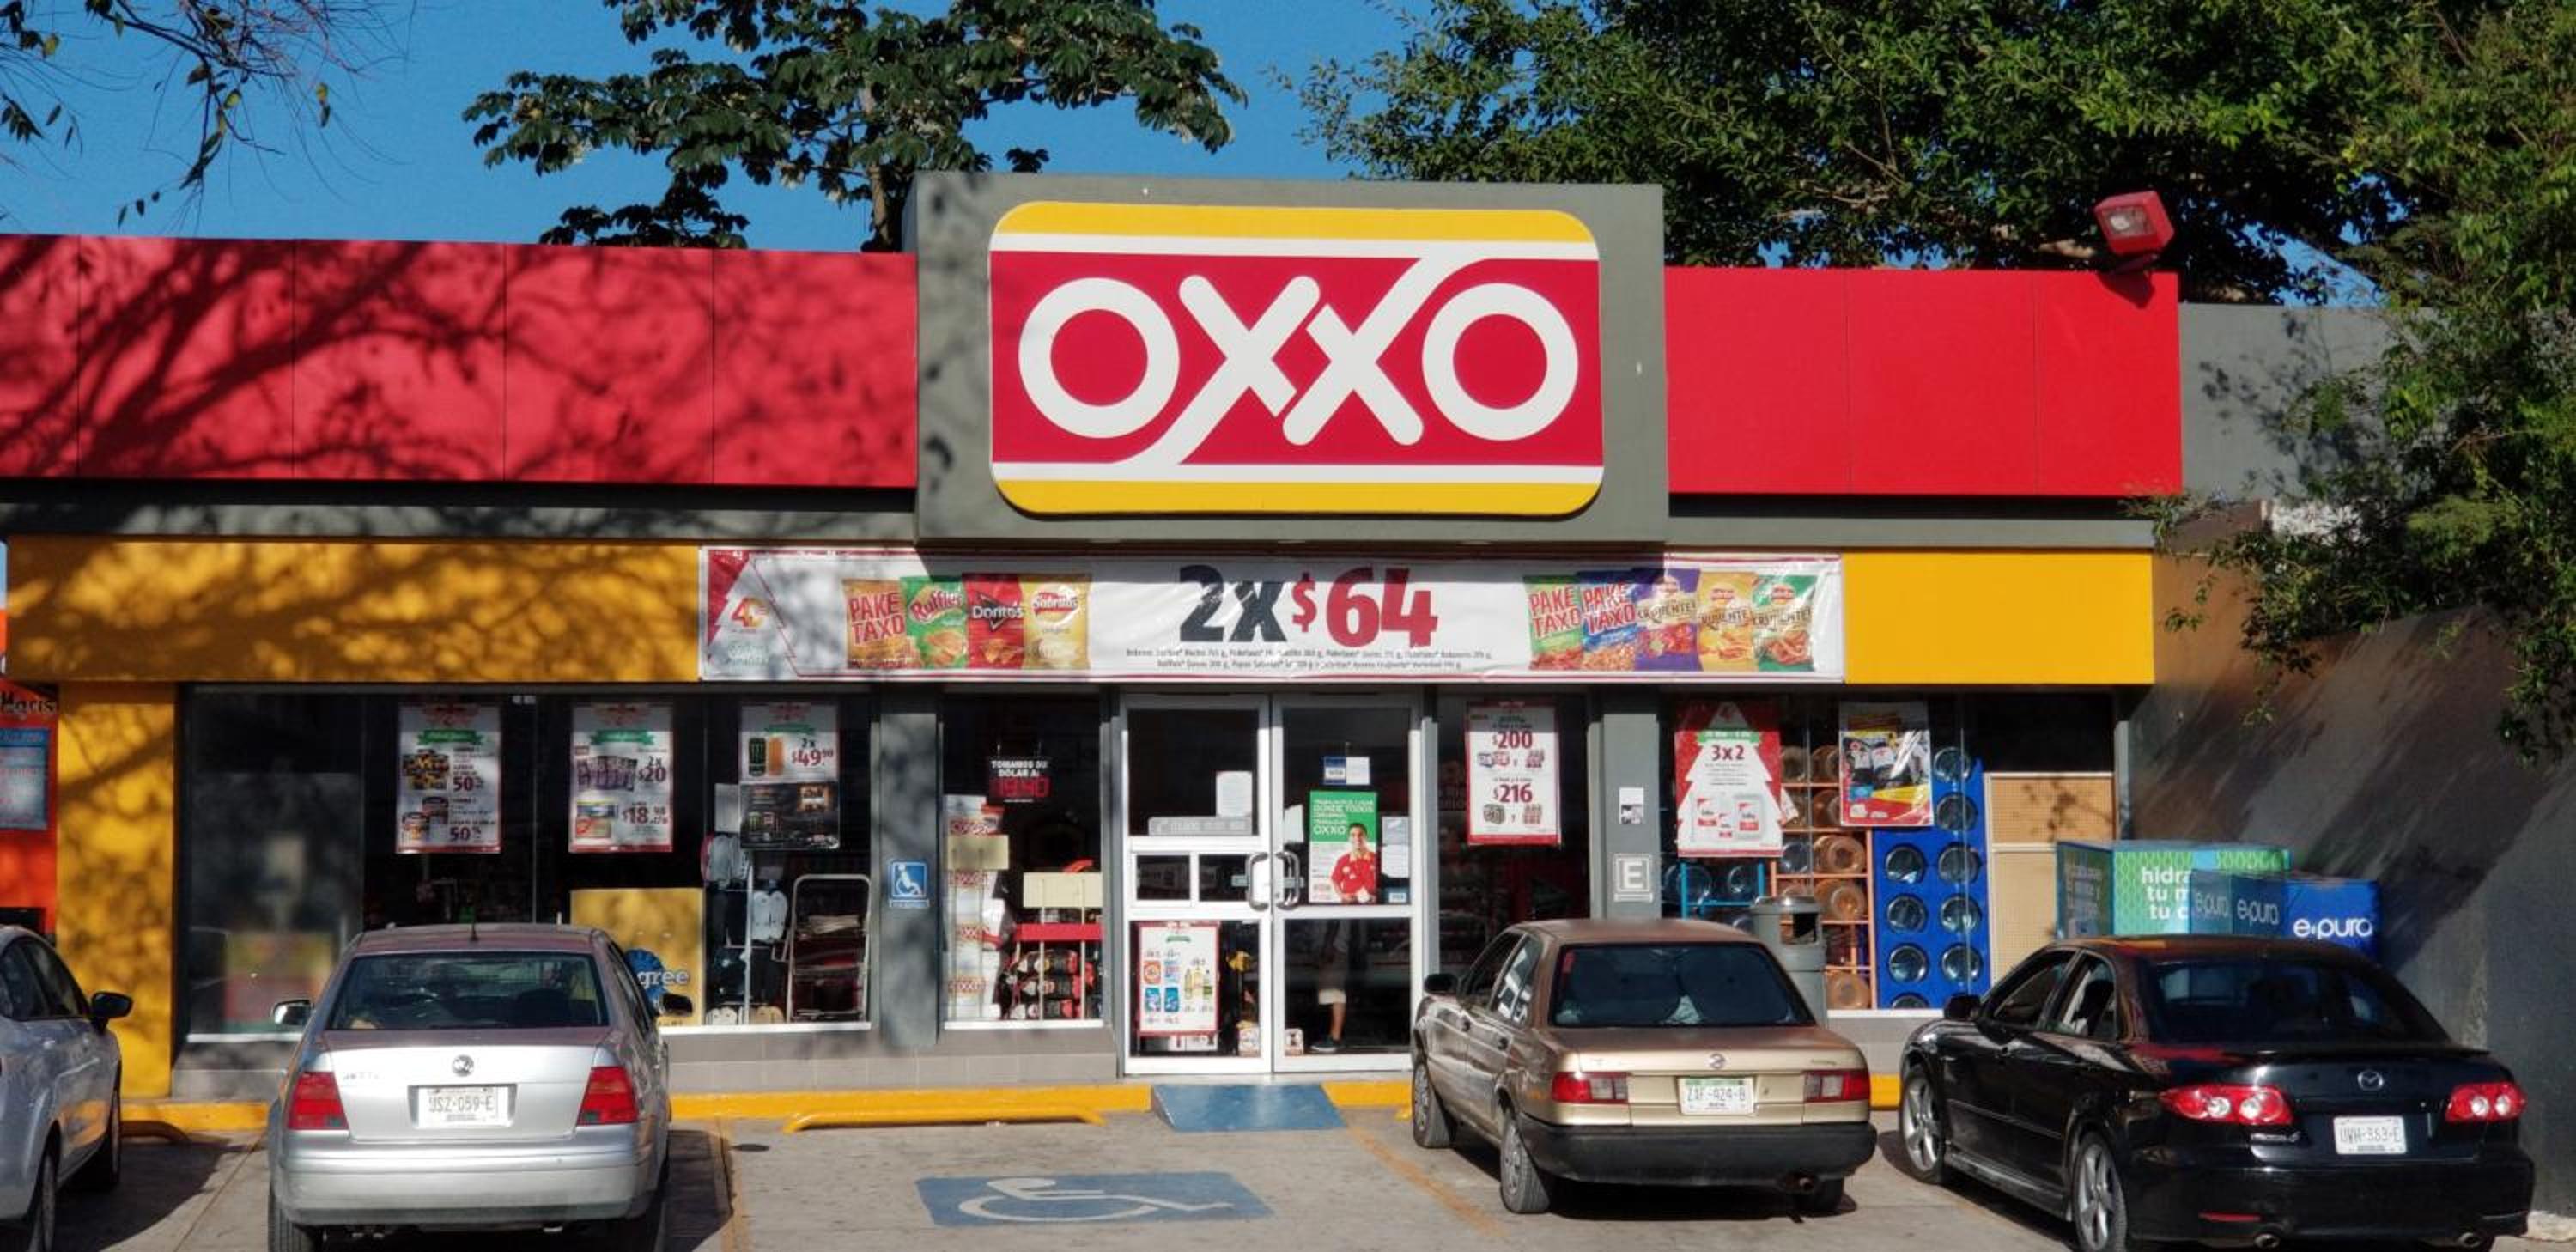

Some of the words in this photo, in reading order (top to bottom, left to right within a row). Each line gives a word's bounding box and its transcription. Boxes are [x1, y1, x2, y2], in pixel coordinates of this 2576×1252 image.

[1018, 268, 1578, 457] OXXO
[849, 592, 899, 622] PAKE
[1292, 567, 1438, 648] $64
[1529, 586, 1574, 613] PAKE
[972, 604, 1024, 619] Doritos
[852, 614, 905, 643] TAXO
[1533, 608, 1580, 637] TAXO
[1492, 731, 1533, 749] $200
[1711, 744, 1745, 761] 3x2
[1493, 783, 1533, 803] $216
[1313, 825, 1346, 835] OXXO
[1623, 861, 1643, 889] E
[2147, 886, 2168, 902] tu
[2149, 904, 2171, 920] tu
[637, 969, 690, 989] gree
